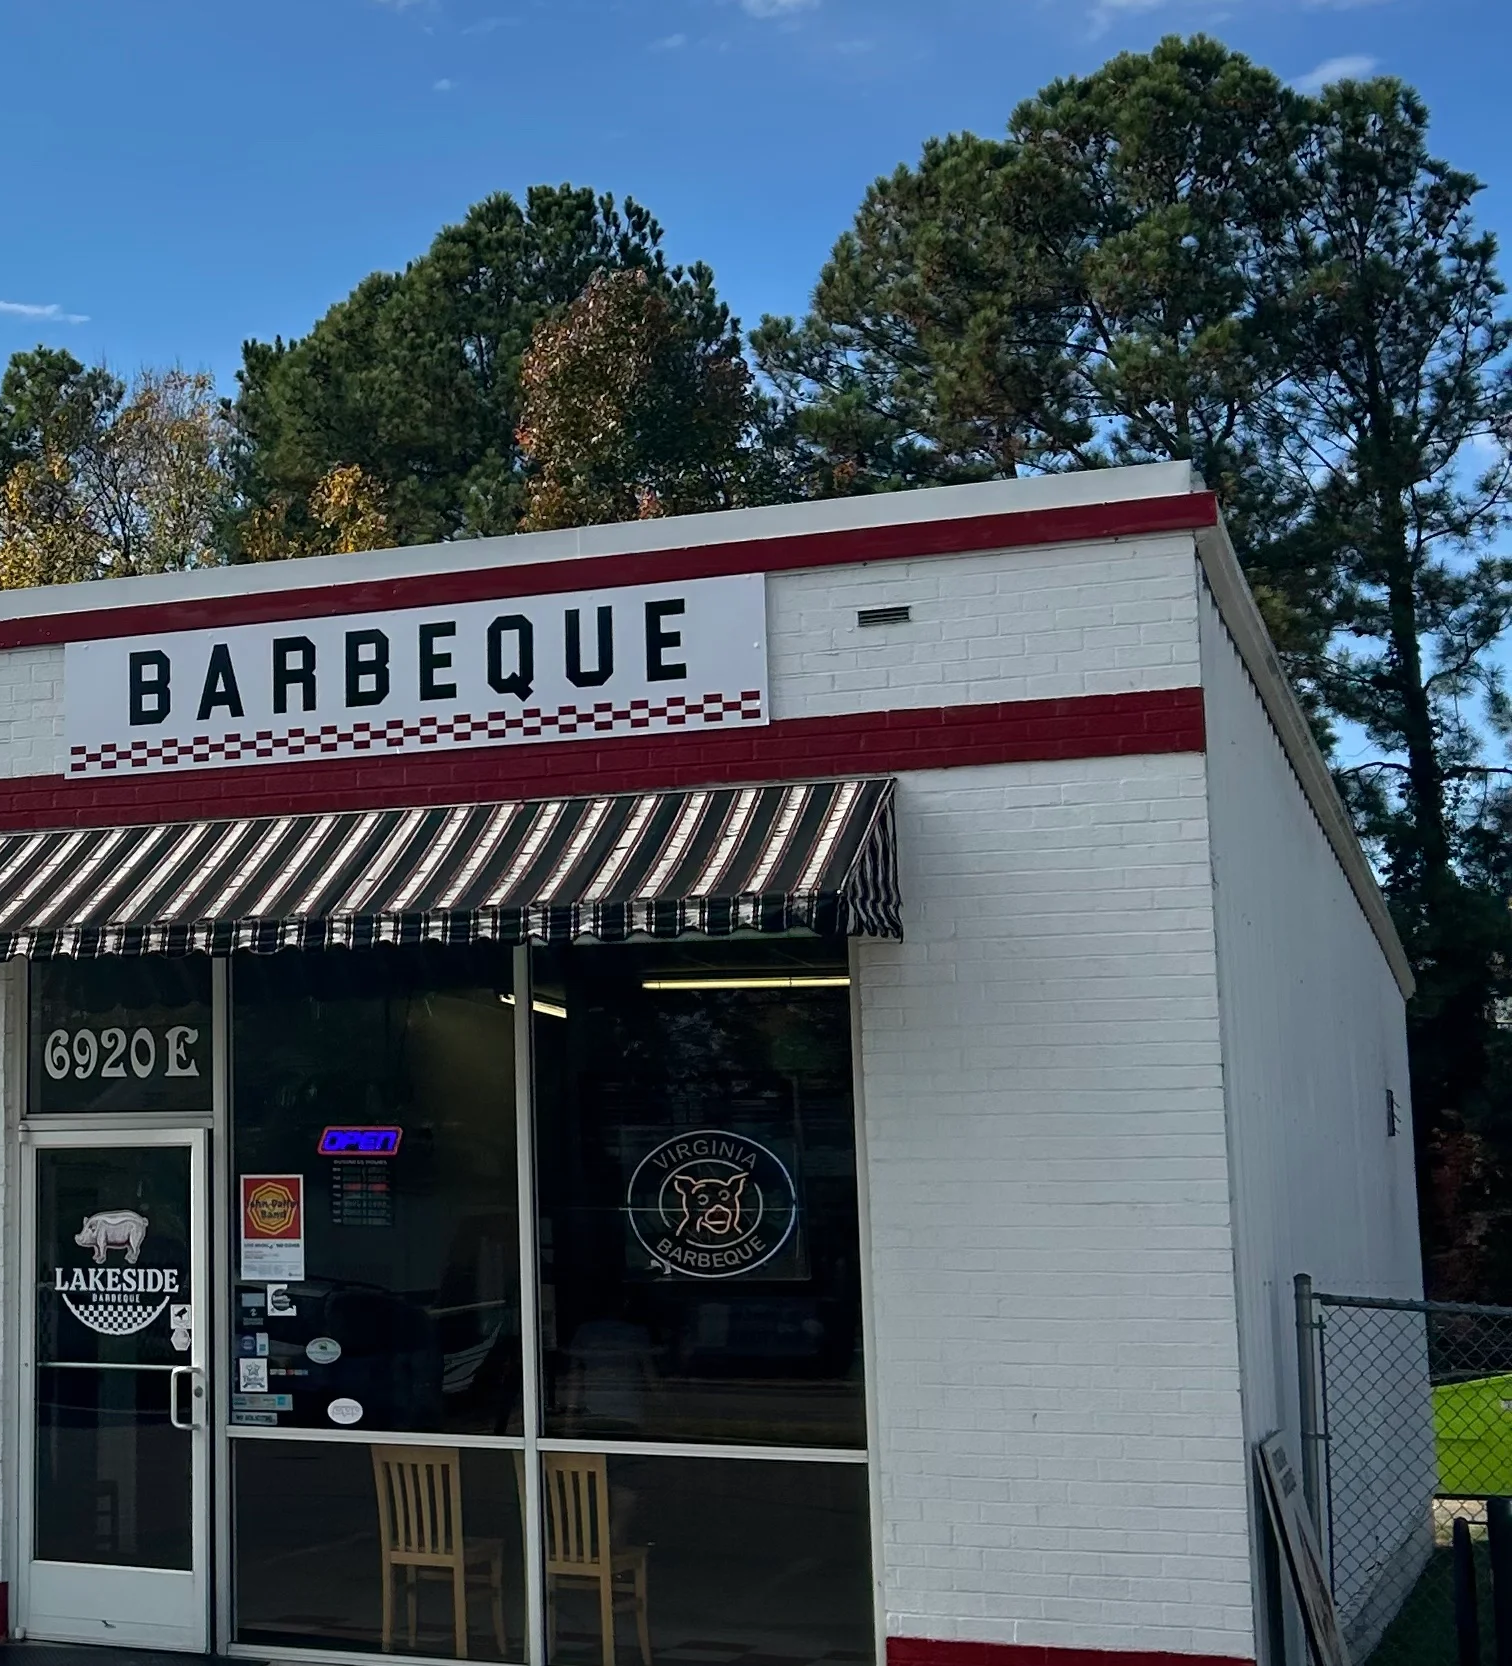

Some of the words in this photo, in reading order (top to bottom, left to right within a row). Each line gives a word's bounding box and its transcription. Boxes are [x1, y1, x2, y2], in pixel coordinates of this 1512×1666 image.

[129, 597, 687, 726] BARBEQUE
[44, 1026, 156, 1080] 6920
[164, 1025, 200, 1078] E
[323, 1130, 398, 1152] OPEN
[652, 1139, 757, 1170] VIRGINIA
[656, 1235, 766, 1268] BARBEQUE
[54, 1267, 180, 1293] LAKESIDE
